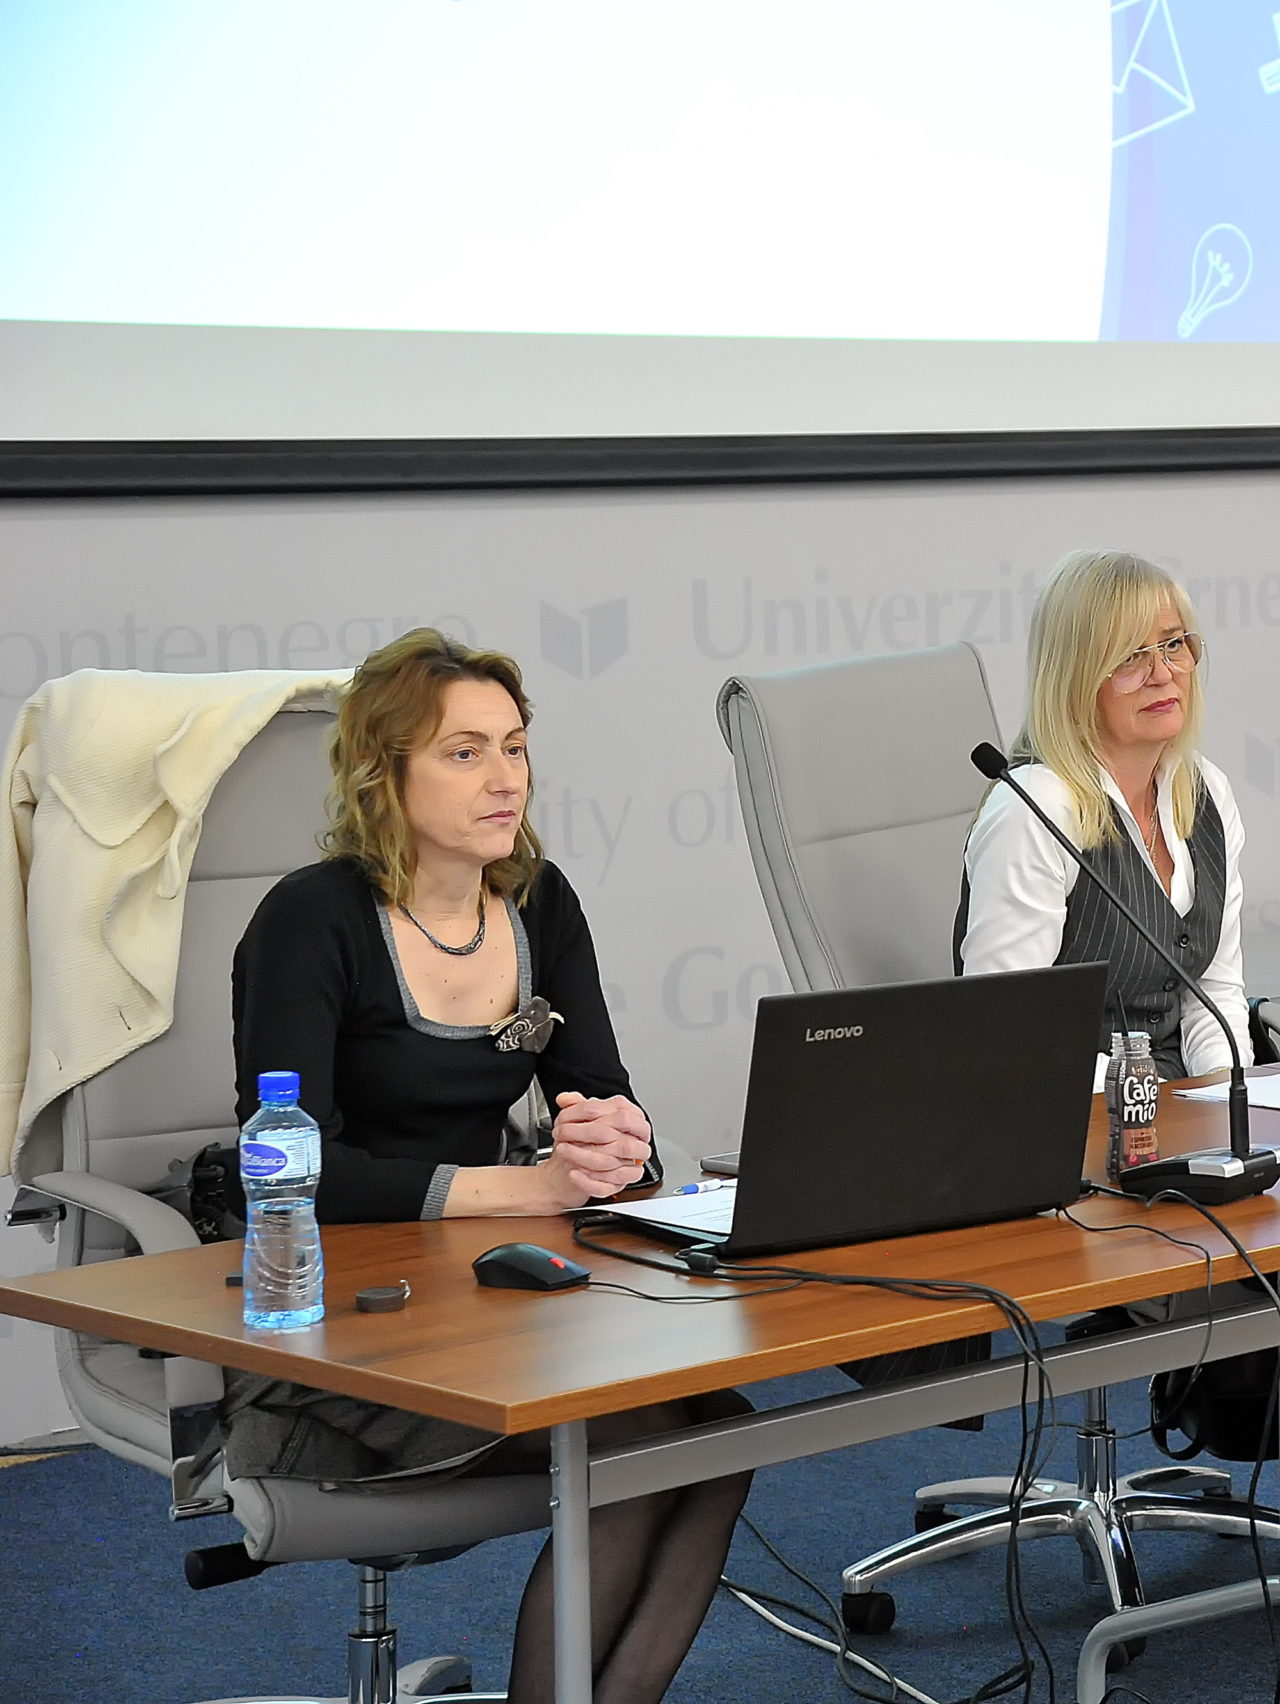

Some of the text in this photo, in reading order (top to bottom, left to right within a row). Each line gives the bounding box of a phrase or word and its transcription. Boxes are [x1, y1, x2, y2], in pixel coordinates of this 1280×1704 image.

[805, 1025, 864, 1042] Lenovo
[1123, 1075, 1158, 1104] Cafe
[1123, 1102, 1156, 1122] mio
